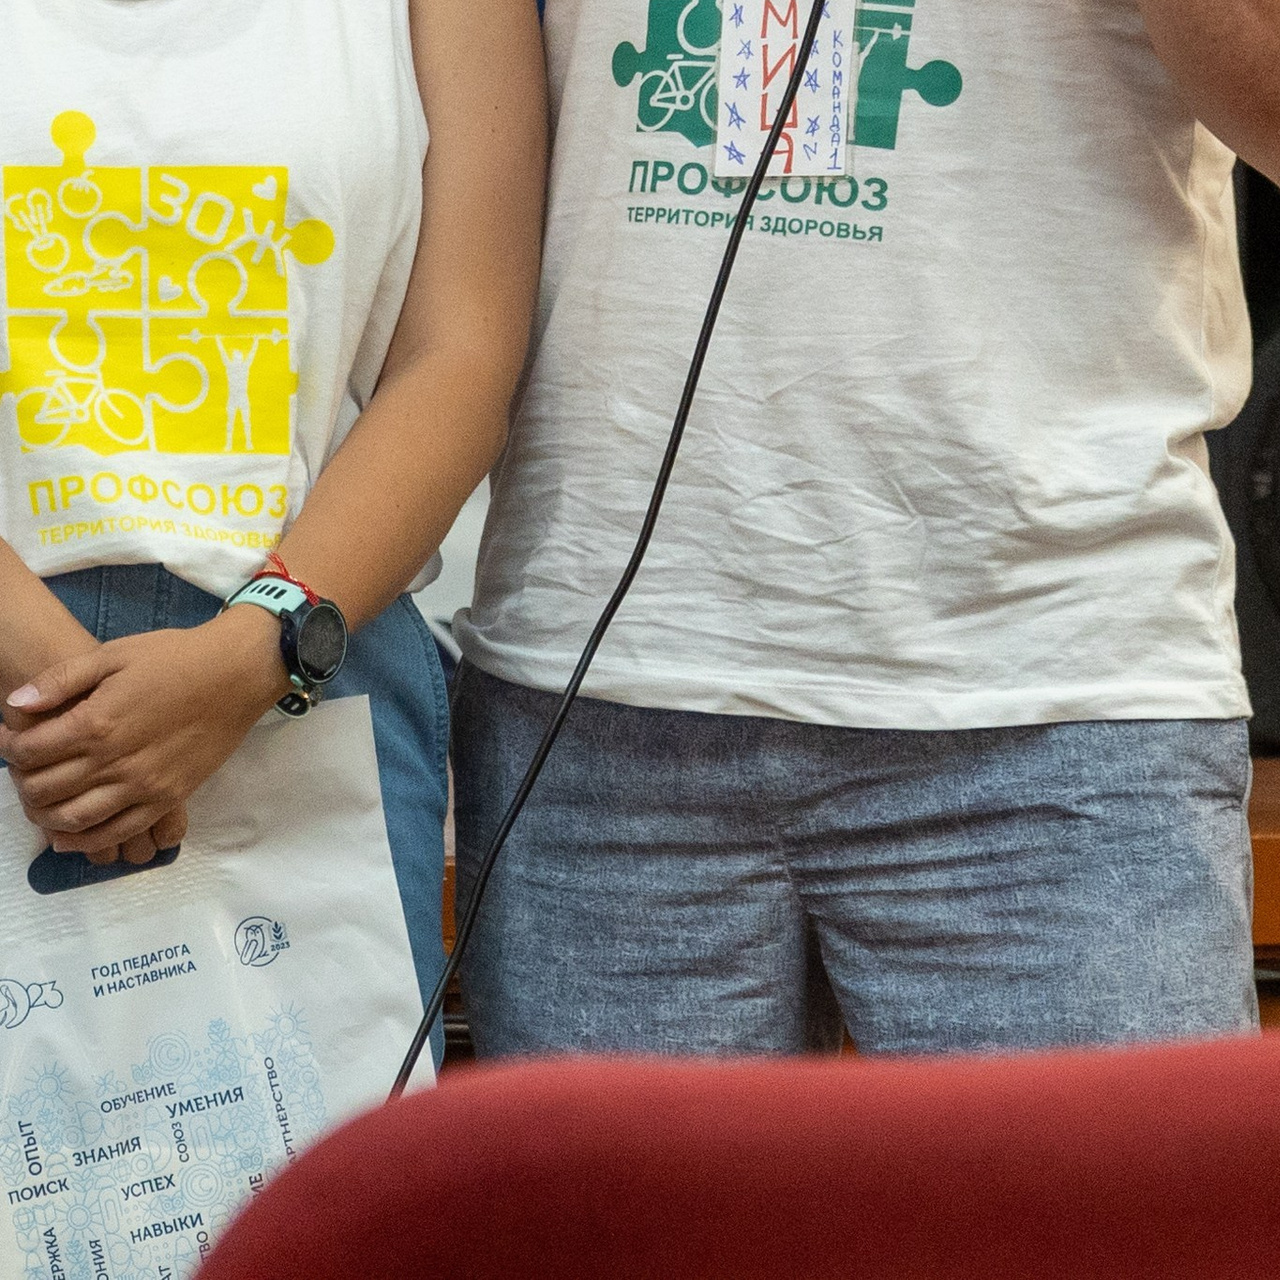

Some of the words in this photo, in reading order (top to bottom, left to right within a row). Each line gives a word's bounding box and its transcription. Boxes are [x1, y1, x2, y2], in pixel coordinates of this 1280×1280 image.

[147, 172, 292, 277] ЗОЖ
[627, 206, 754, 232] ТЕРРИТОРИЯ
[759, 215, 884, 243] ЗДОРОВЬЯ
[27, 470, 289, 520] ПРОФСОЮЗ
[37, 514, 178, 548] ТЕРРИТОРИЯ
[91, 963, 122, 981] ГОД
[122, 943, 191, 972] ПЕДАГОГА
[269, 940, 292, 953] 2023
[93, 984, 105, 999] И
[107, 960, 198, 996] НАСТАВНИКА
[100, 1082, 177, 1114] ОБУЧЕНИЕ
[165, 1086, 245, 1119] УМЕНИЯ
[18, 1120, 43, 1176] ОПЫТ
[72, 1136, 142, 1167] ЗНАНИЯ
[171, 1121, 190, 1163] СОЮЗ
[7, 1177, 70, 1205] ПОИСК
[121, 1173, 177, 1201] УСПЕХ
[130, 1212, 205, 1244] НАВЫКИ
